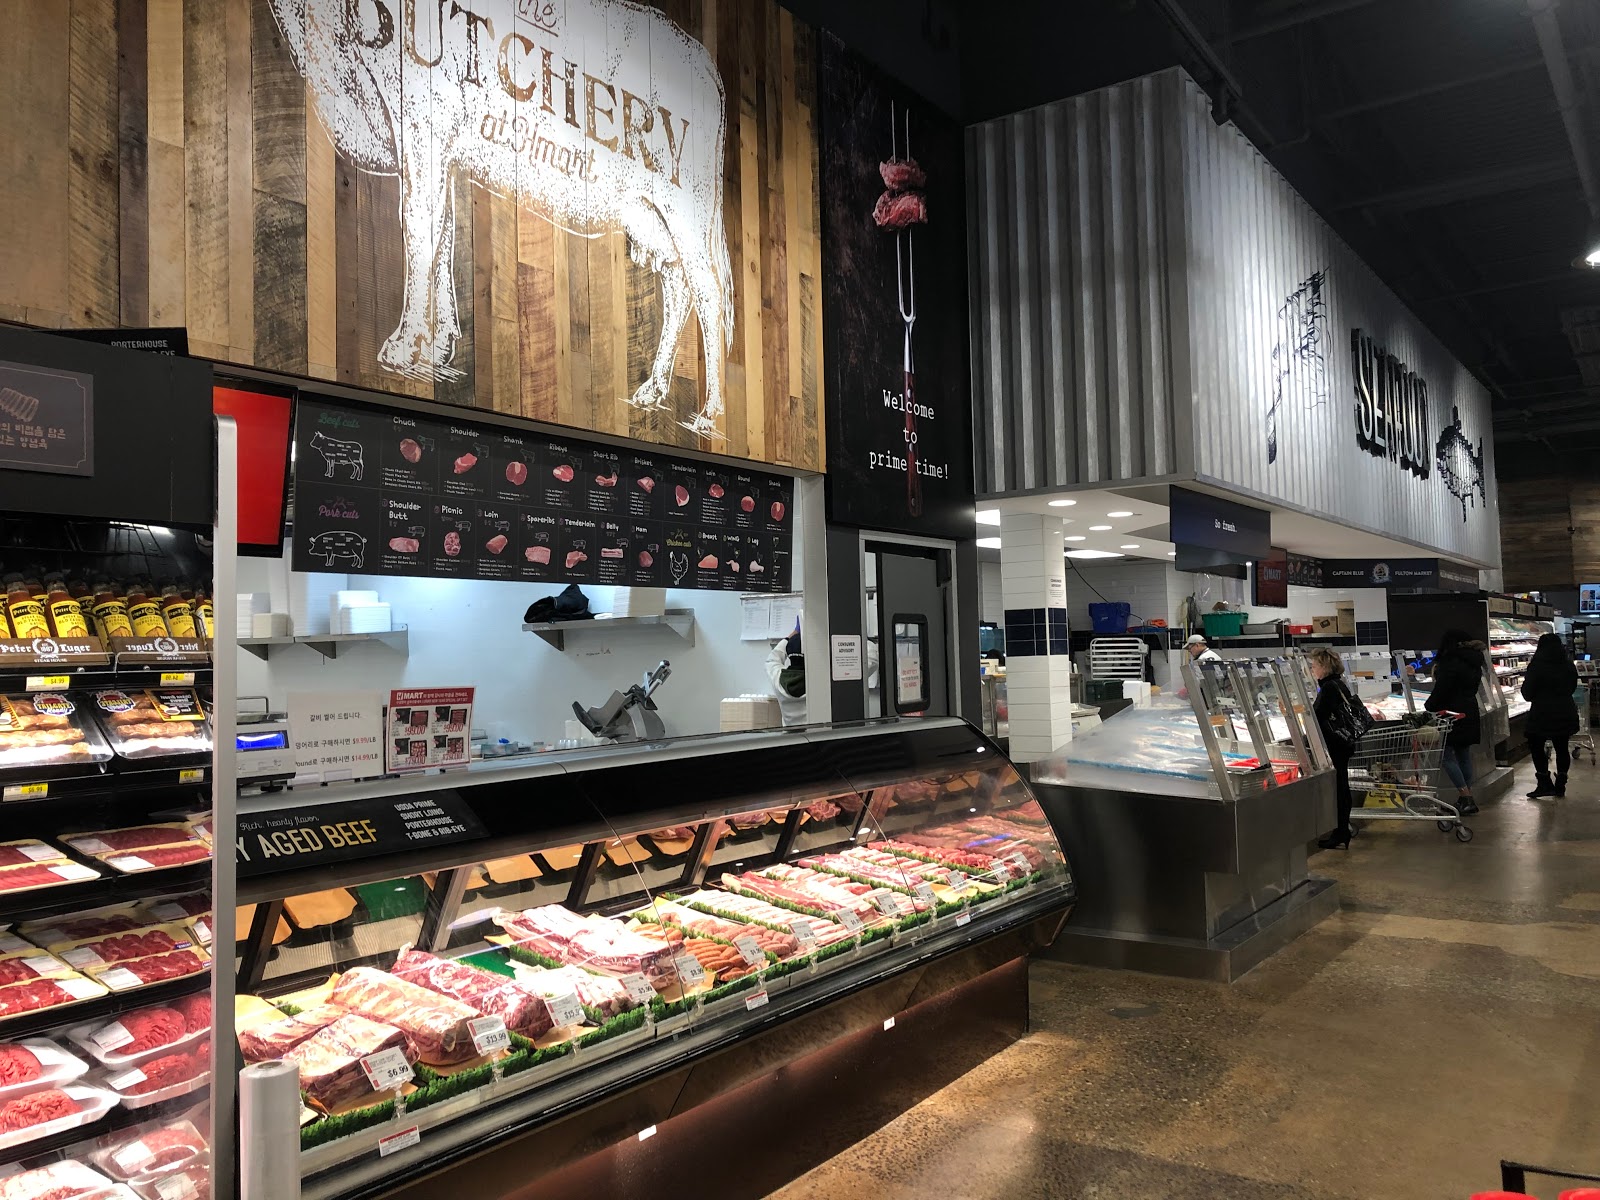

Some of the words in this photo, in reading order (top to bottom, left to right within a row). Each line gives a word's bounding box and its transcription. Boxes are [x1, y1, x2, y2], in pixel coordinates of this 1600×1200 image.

[481, 110, 511, 147] at
[882, 389, 935, 420] Welcome
[393, 416, 416, 428] Chuck
[450, 426, 480, 438] Shoulder
[903, 426, 918, 444] to
[503, 435, 524, 445] Shank
[549, 443, 568, 454] Ribeye
[593, 450, 610, 460] Short
[869, 450, 908, 471] prime
[915, 459, 948, 480] time!
[389, 500, 421, 511] Shoulder
[441, 505, 463, 515] Picnic
[318, 504, 341, 518] Pork
[342, 510, 360, 519] cuts
[388, 510, 409, 521] Butt
[484, 510, 499, 519] Loin
[527, 515, 555, 525] Spareribs
[564, 518, 596, 528] Tenderloin
[1214, 518, 1221, 528] So
[606, 522, 620, 531] Belly
[635, 525, 648, 533] Ham
[0, 643, 31, 653] Peter
[59, 643, 91, 654] Luger
[310, 714, 322, 722] 갈비
[321, 738, 351, 747] 구매하시면
[352, 736, 377, 745] $9.99/LB
[320, 755, 350, 765] 구매하시면
[394, 803, 415, 811] USDA
[413, 799, 437, 809] PRIME
[400, 810, 424, 820] SHORT
[422, 808, 445, 817] LOINS
[266, 818, 294, 828] hearty
[405, 816, 454, 830] PORTERHOUSE
[405, 829, 433, 840] T-BONE
[438, 824, 467, 835] RIB-EYE
[236, 836, 251, 863] Y
[257, 827, 324, 859] AGED
[320, 819, 377, 849] BEEF
[486, 1032, 507, 1044] $13.99
[387, 1064, 409, 1078] $6.99
